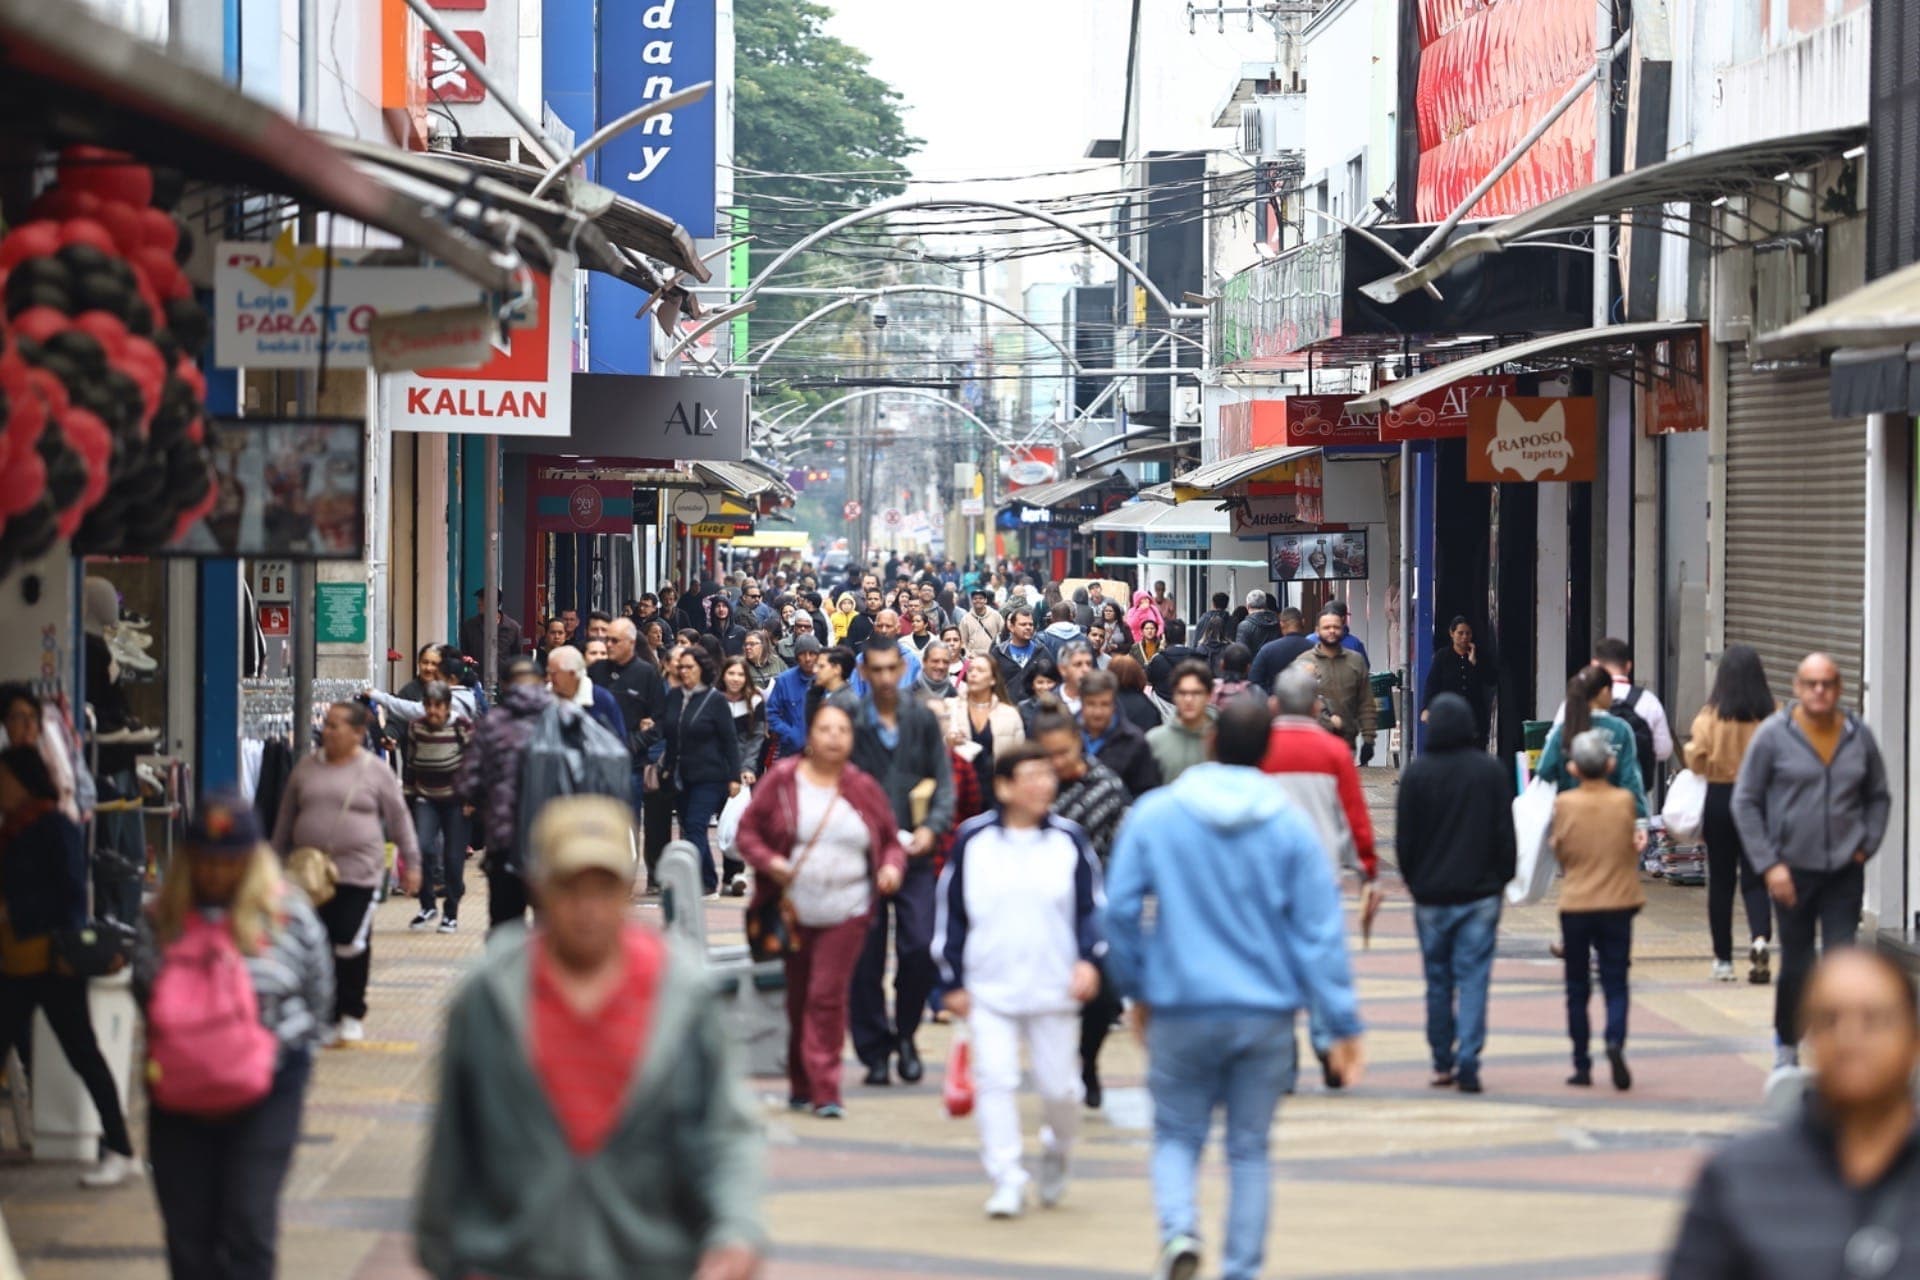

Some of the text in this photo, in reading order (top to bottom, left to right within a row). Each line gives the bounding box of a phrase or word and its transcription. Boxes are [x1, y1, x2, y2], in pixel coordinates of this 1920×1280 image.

[627, 0, 674, 182] danny
[237, 290, 289, 314] Loja
[407, 387, 547, 419] KALLAN
[1497, 430, 1563, 453] RAPOSO
[1521, 448, 1565, 462] tapetes
[697, 524, 725, 535] LIVRE
